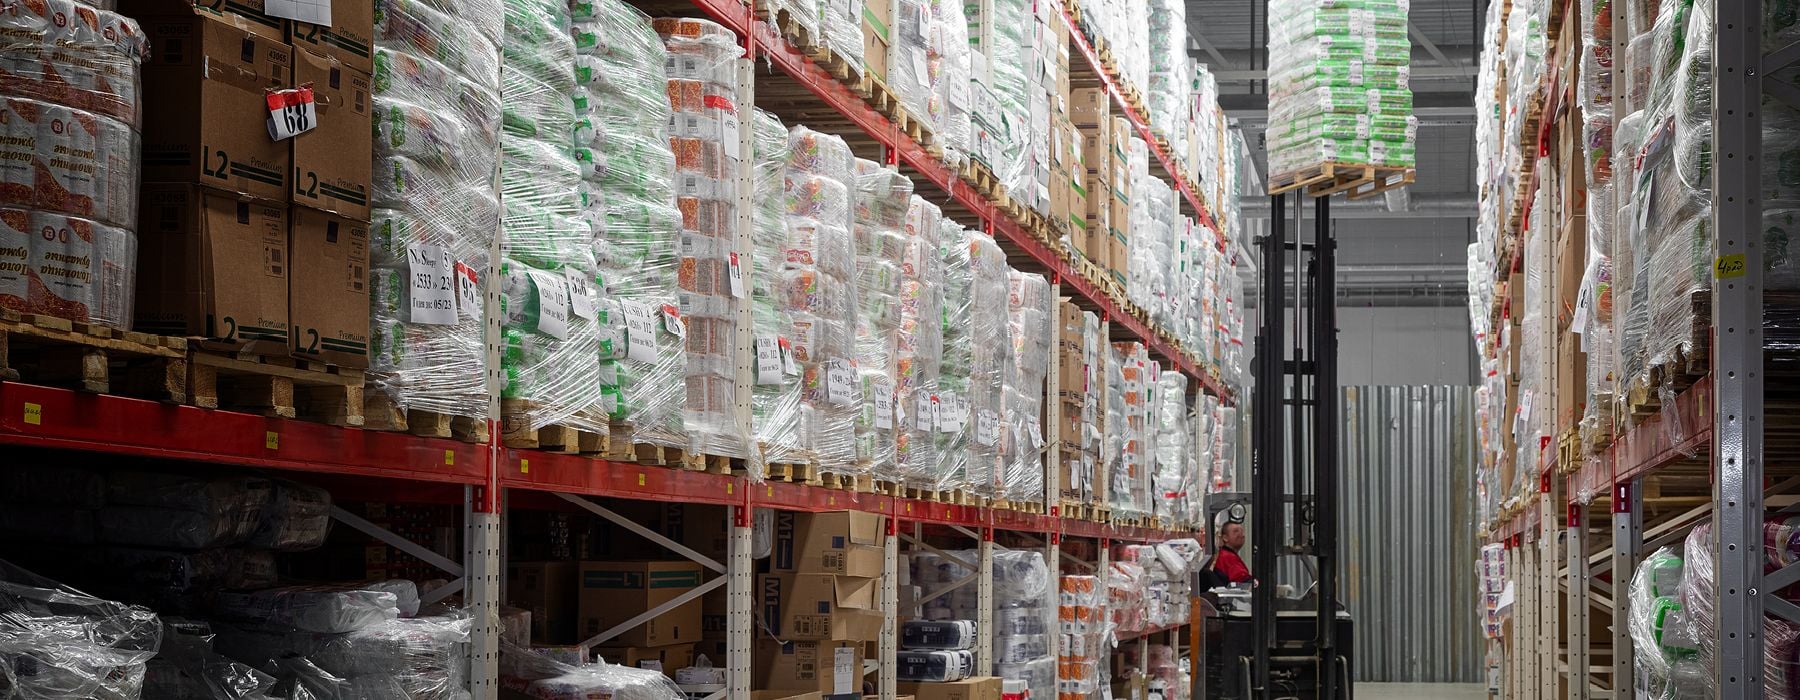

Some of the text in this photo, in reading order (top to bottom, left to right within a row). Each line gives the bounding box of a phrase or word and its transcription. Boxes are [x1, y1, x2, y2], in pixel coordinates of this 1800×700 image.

[339, 27, 369, 44] Premium
[283, 102, 309, 134] 68
[202, 145, 228, 180] L2
[251, 156, 282, 173] Premium
[295, 166, 318, 199] L2
[434, 300, 451, 310] 05/23
[258, 317, 287, 330] Premium
[339, 330, 365, 342] Premium
[295, 325, 319, 355] L2
[778, 513, 793, 540] M1
[766, 579, 779, 606] M1
